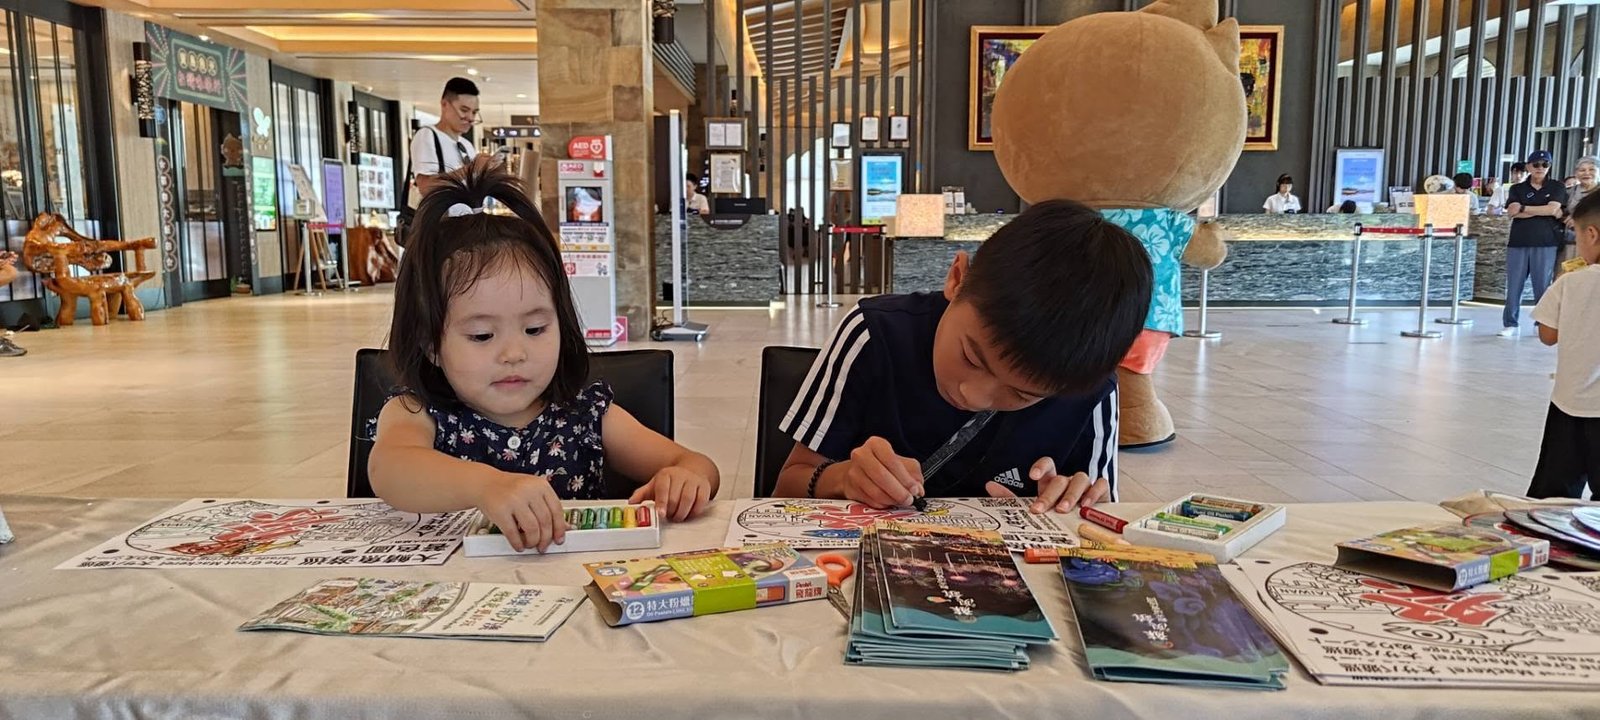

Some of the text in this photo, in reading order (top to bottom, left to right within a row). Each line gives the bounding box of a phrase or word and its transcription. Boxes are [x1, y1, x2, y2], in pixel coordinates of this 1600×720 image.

[994, 474, 1025, 489] adidas
[1280, 588, 1331, 596] TAIWAN
[629, 604, 643, 614] 12
[1452, 648, 1539, 659] Coloring
[1431, 653, 1518, 666] Mackerel
[1523, 661, 1576, 670] Great
[1447, 666, 1535, 676] Mackerel
